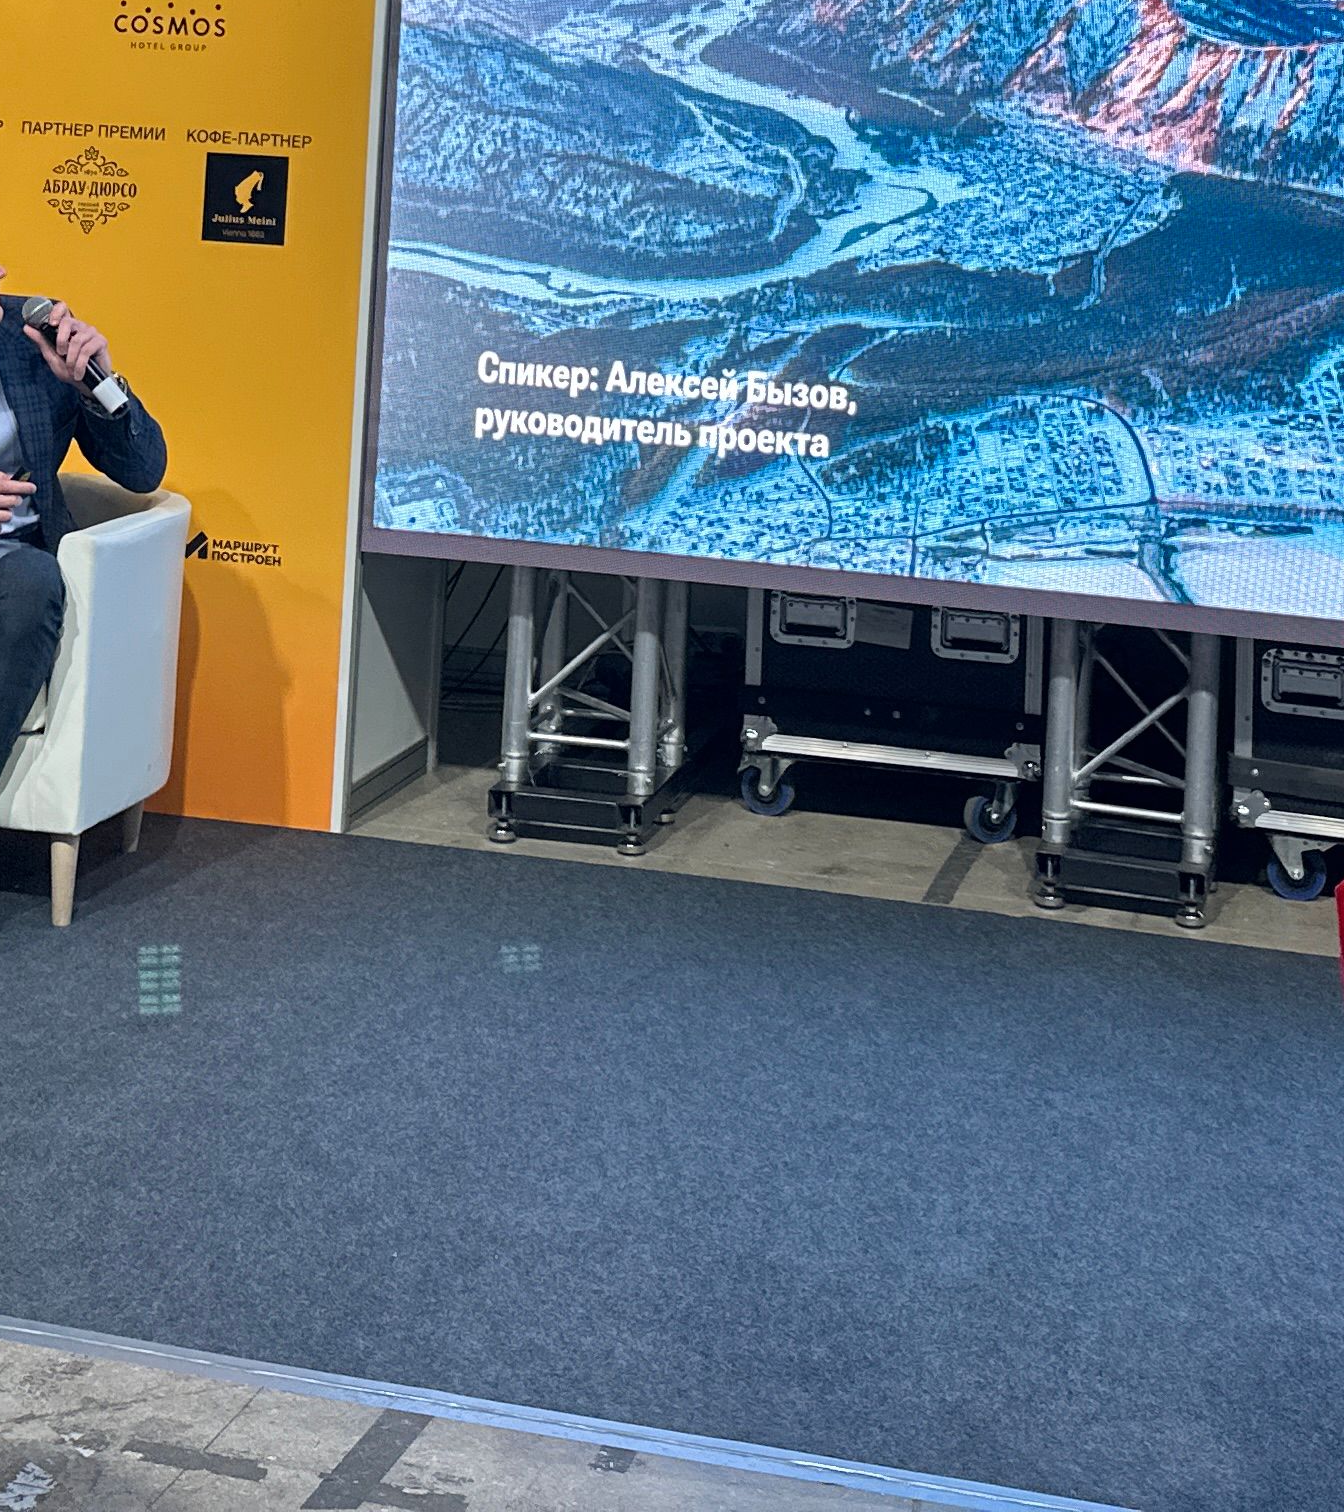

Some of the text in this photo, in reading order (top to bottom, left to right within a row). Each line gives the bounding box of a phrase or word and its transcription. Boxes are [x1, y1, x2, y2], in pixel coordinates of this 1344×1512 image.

[114, 14, 225, 37] COSMOS
[131, 42, 207, 51] HOTEL GROUP
[21, 120, 166, 141] ПАРТНЕР ПРЕМИИ
[186, 129, 312, 148] КОФЕ-ПАРТНЕР
[478, 350, 856, 416] Спикер: Алексей Бызов,
[474, 407, 830, 459] руководитель проекта
[212, 539, 280, 555] МАРШРУТ
[211, 550, 282, 567] ПОСТРОЕН
